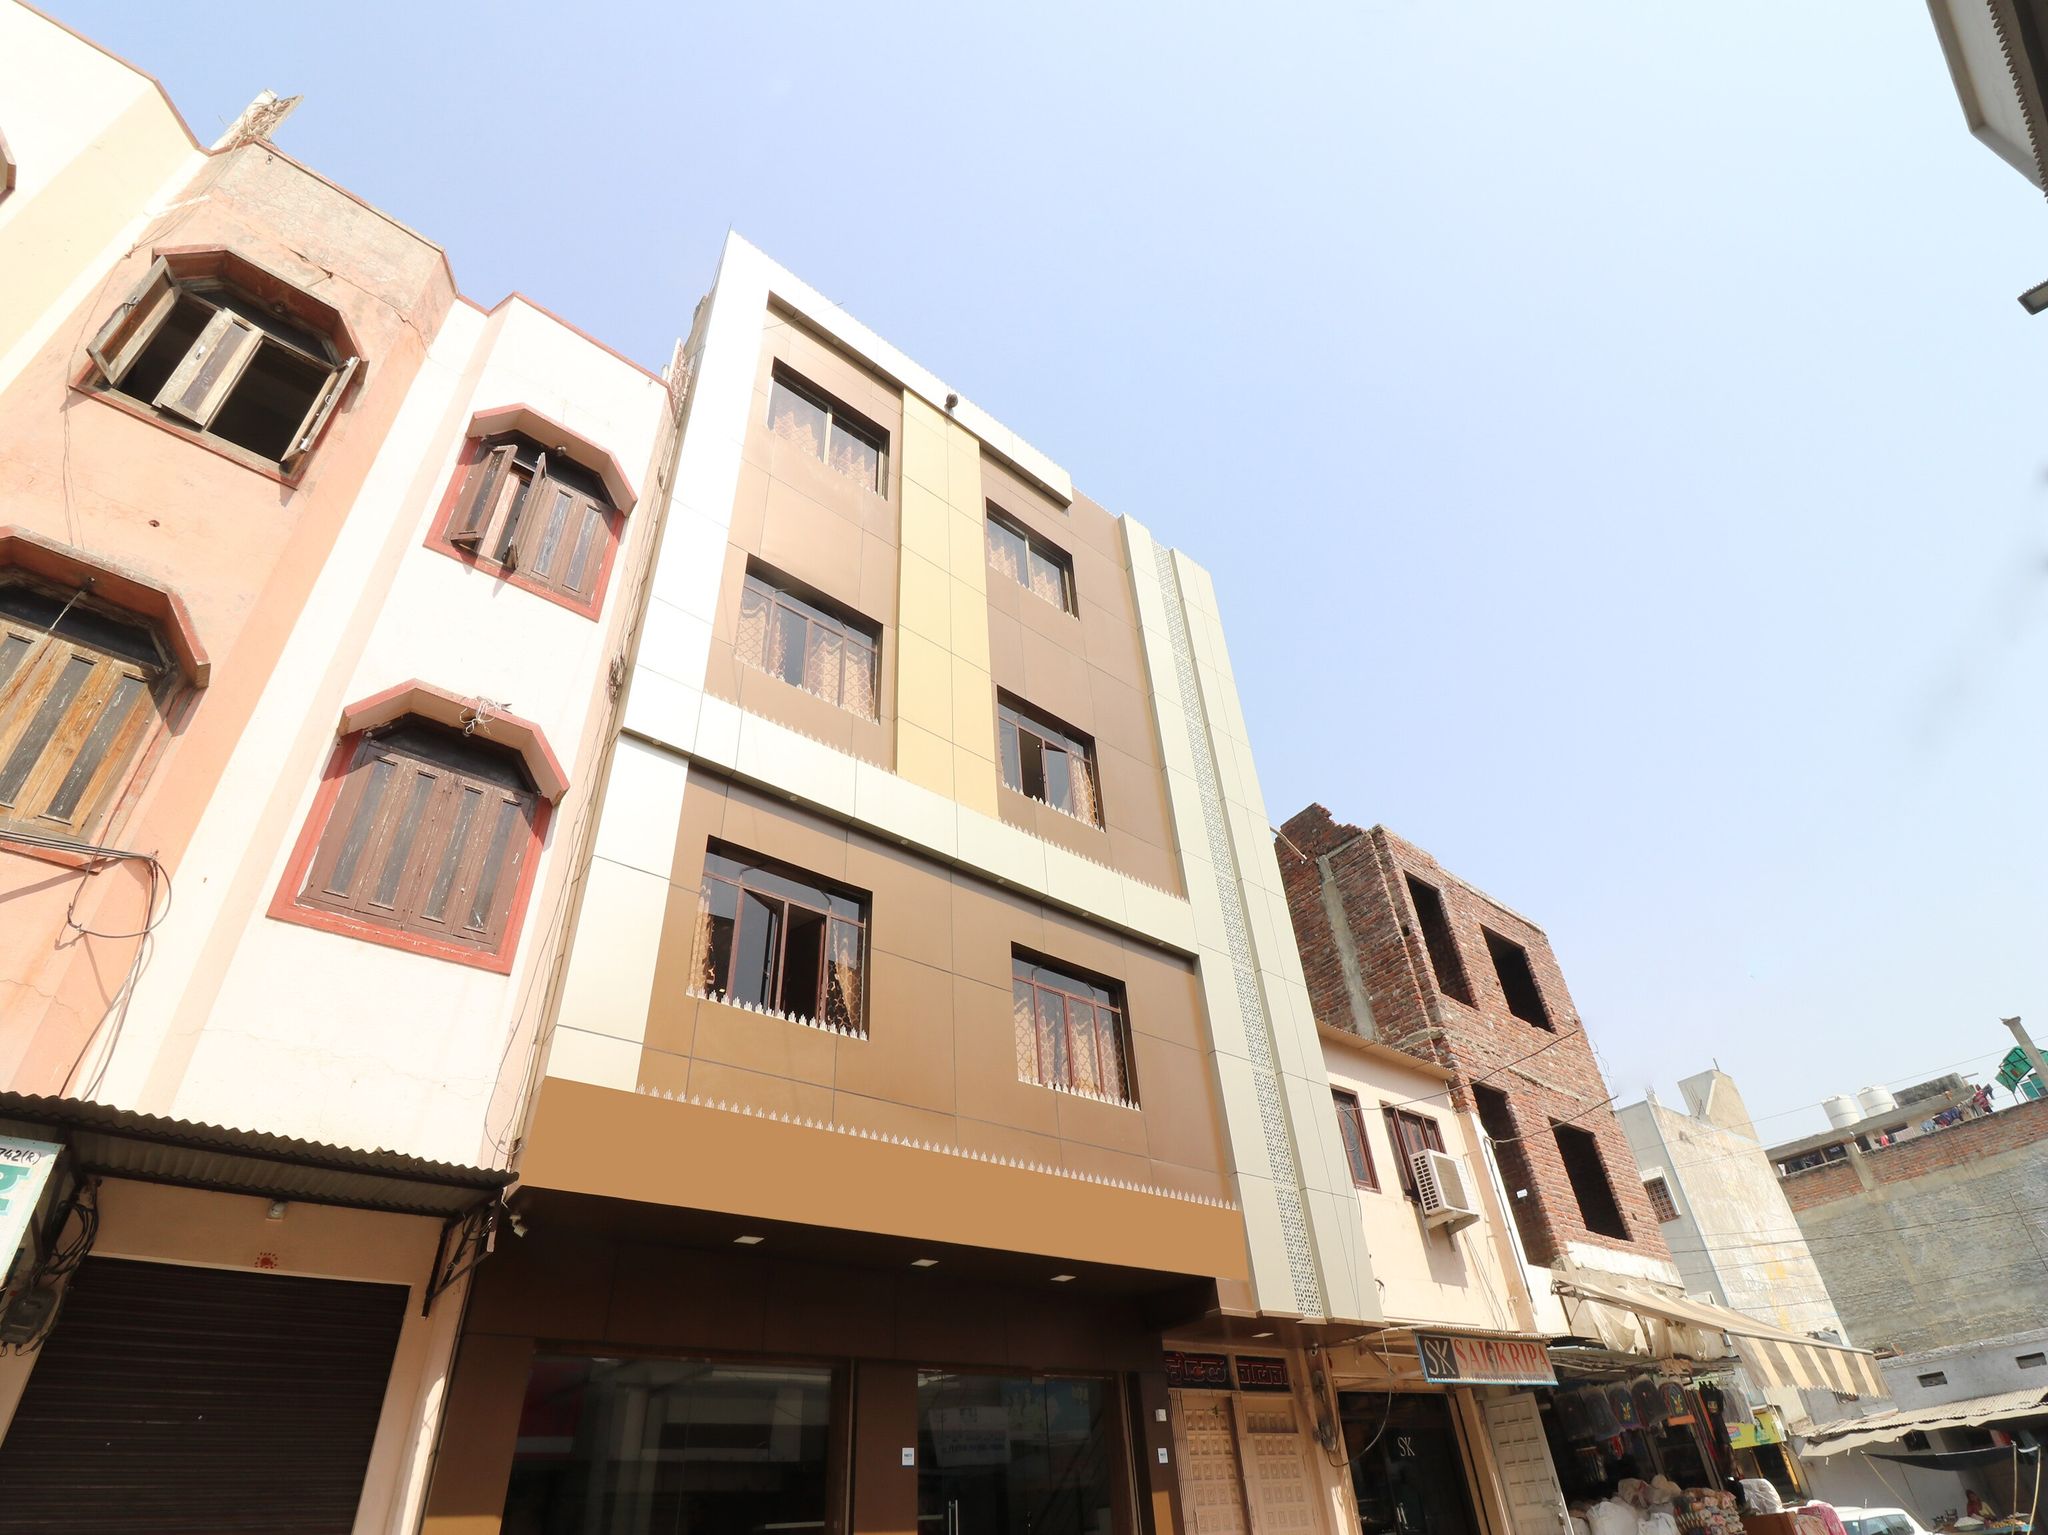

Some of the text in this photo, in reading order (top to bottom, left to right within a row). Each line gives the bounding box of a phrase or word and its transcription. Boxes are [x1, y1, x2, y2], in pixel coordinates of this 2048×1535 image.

[1424, 1339, 1456, 1375] SK
[1454, 1338, 1552, 1373] SAI KRIPA
[1397, 1436, 1416, 1457] SK
